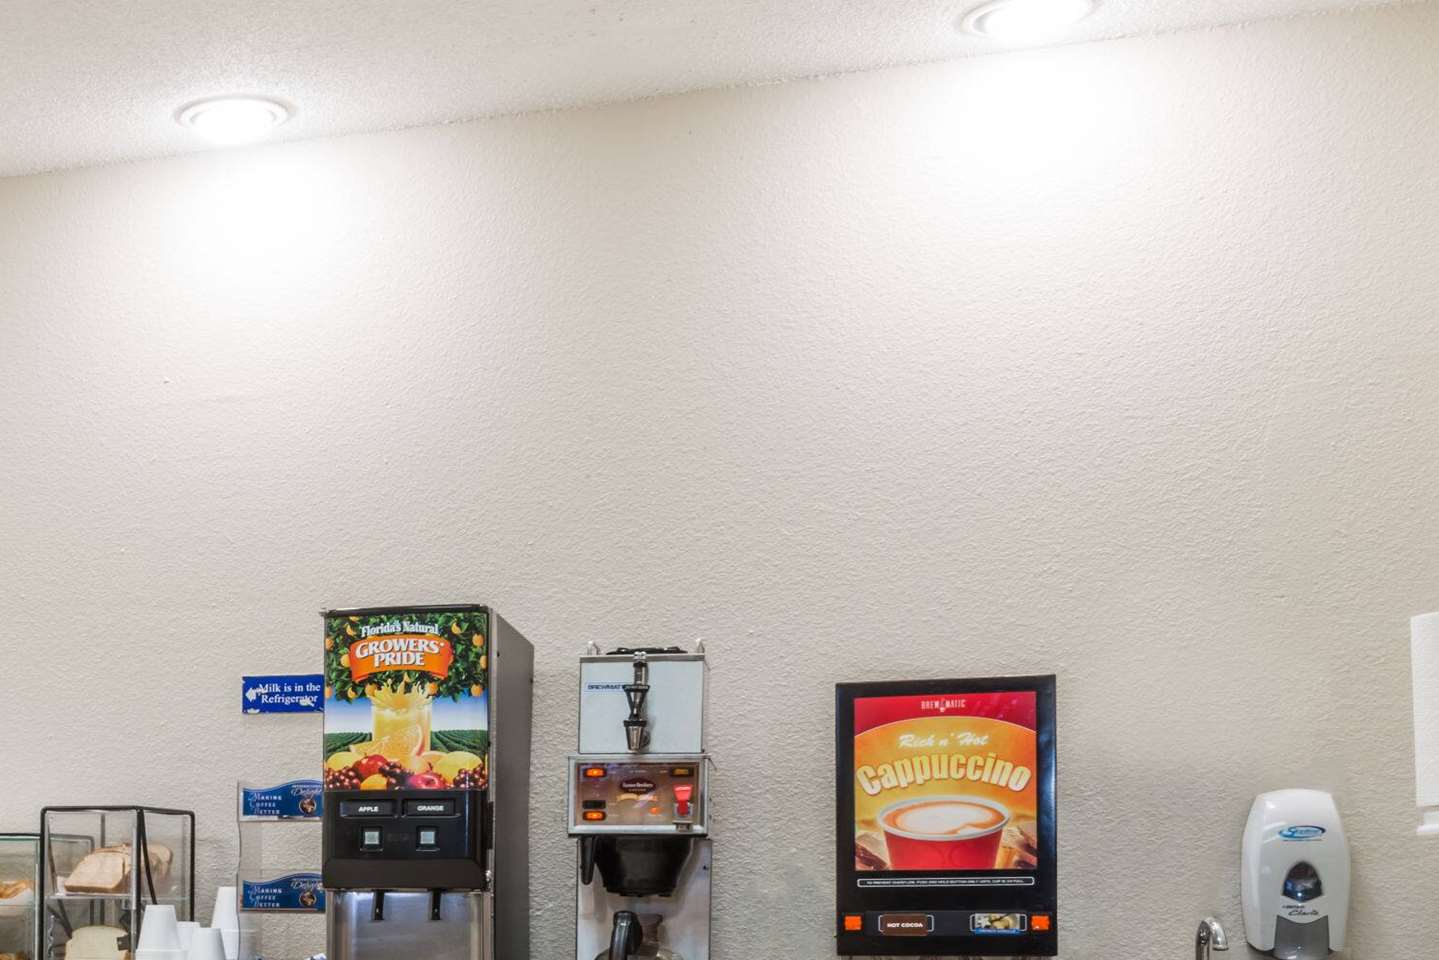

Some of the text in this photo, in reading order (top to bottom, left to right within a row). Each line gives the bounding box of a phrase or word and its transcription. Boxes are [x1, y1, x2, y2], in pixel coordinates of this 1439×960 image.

[361, 621, 440, 637] Florida's Natural
[374, 652, 425, 667] PRIDE
[259, 682, 321, 693] Milk is in the
[261, 694, 318, 705] Refrigerator
[898, 733, 935, 749] Rich
[957, 731, 989, 747] Hot
[856, 752, 1031, 796] Cappuccino
